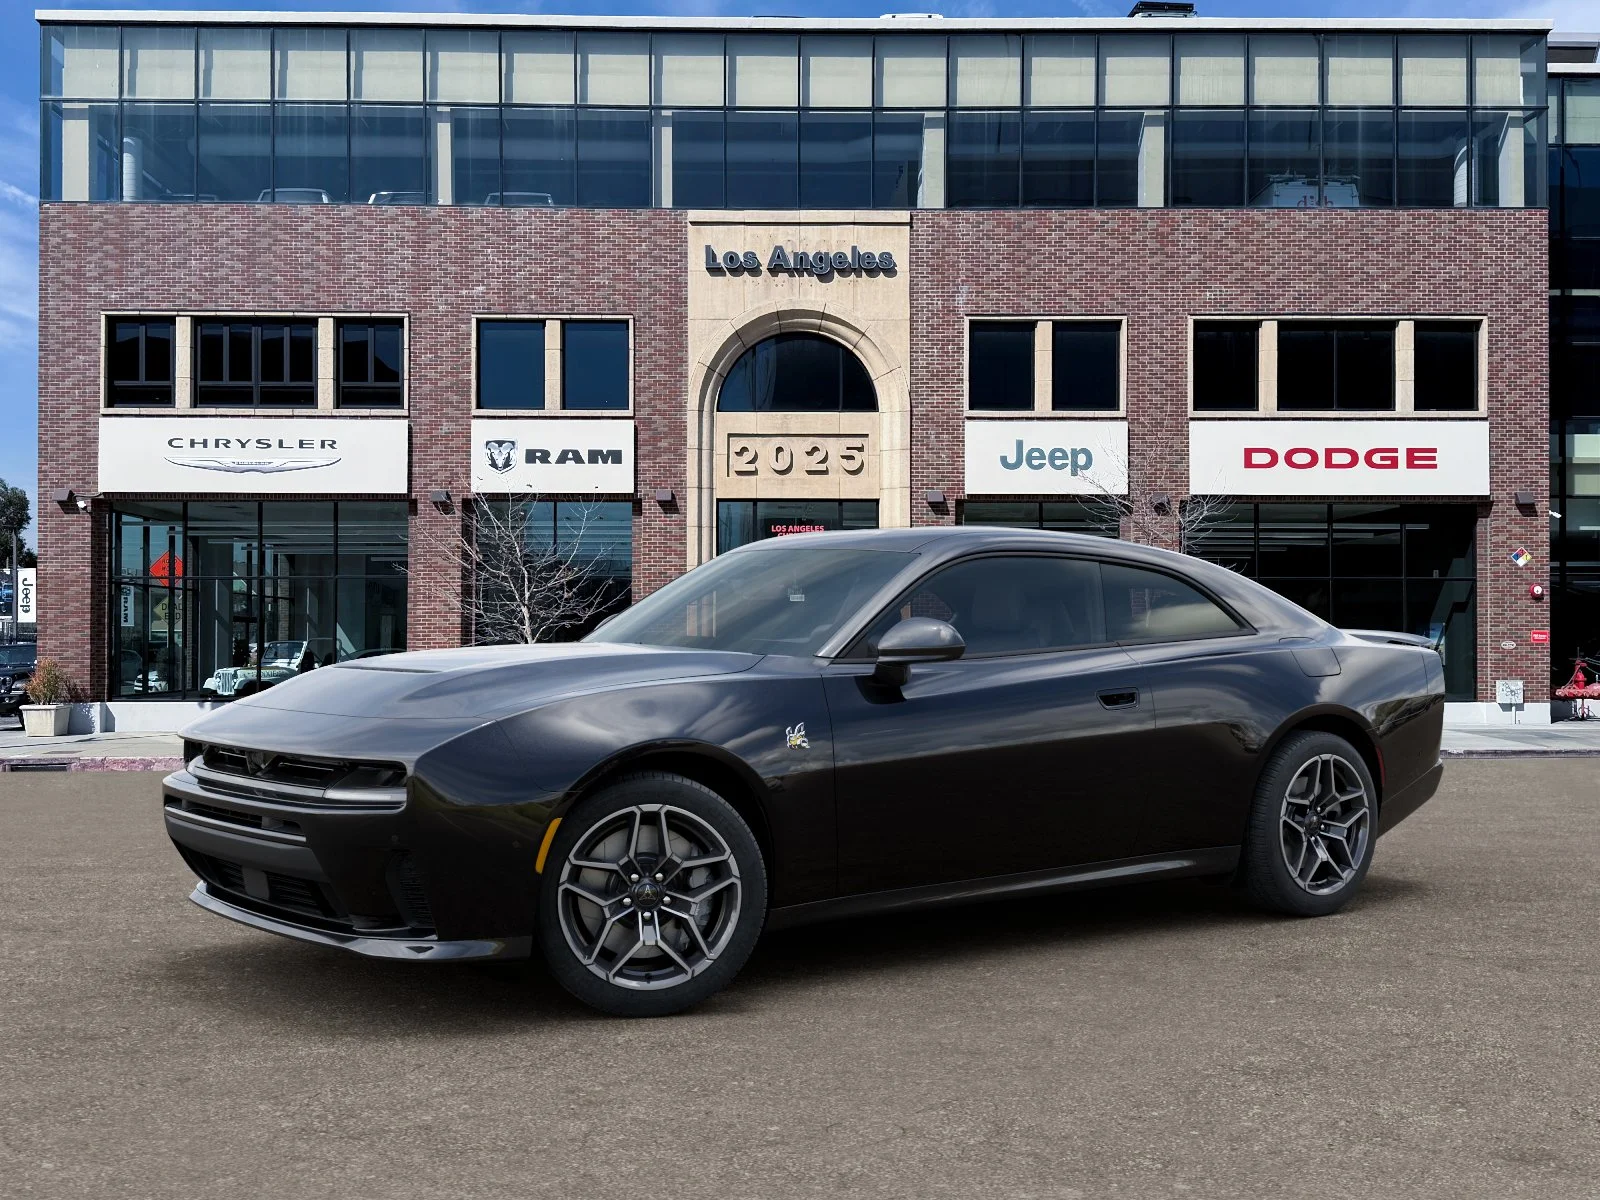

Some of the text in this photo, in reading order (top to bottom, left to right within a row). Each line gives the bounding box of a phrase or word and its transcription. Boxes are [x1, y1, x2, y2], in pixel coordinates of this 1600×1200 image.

[704, 244, 895, 276] Los Angeles
[167, 437, 338, 450] CHRYSLER
[524, 448, 623, 465] RAM
[733, 440, 865, 476] 2025
[999, 439, 1093, 477] Jeep
[1243, 447, 1438, 470] DODGE
[771, 525, 825, 533] LOS ANGELES
[20, 577, 34, 614] Jeep
[161, 602, 183, 611] DA
[164, 612, 181, 620] ED
